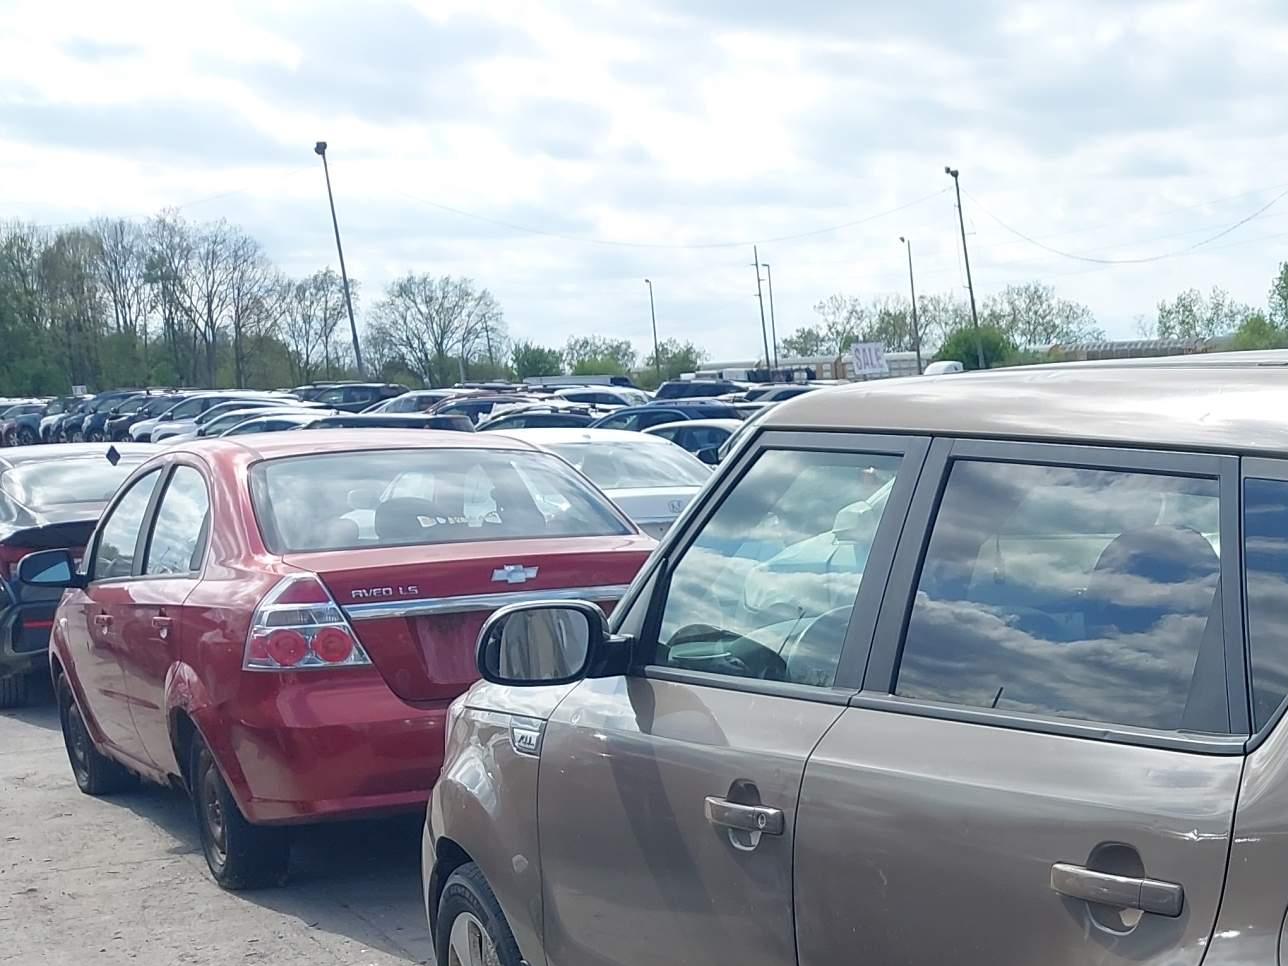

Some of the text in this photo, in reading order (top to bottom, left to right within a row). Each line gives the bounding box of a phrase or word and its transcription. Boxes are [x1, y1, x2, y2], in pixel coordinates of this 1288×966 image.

[854, 347, 884, 370] SALE
[351, 585, 419, 599] AVEO LS
